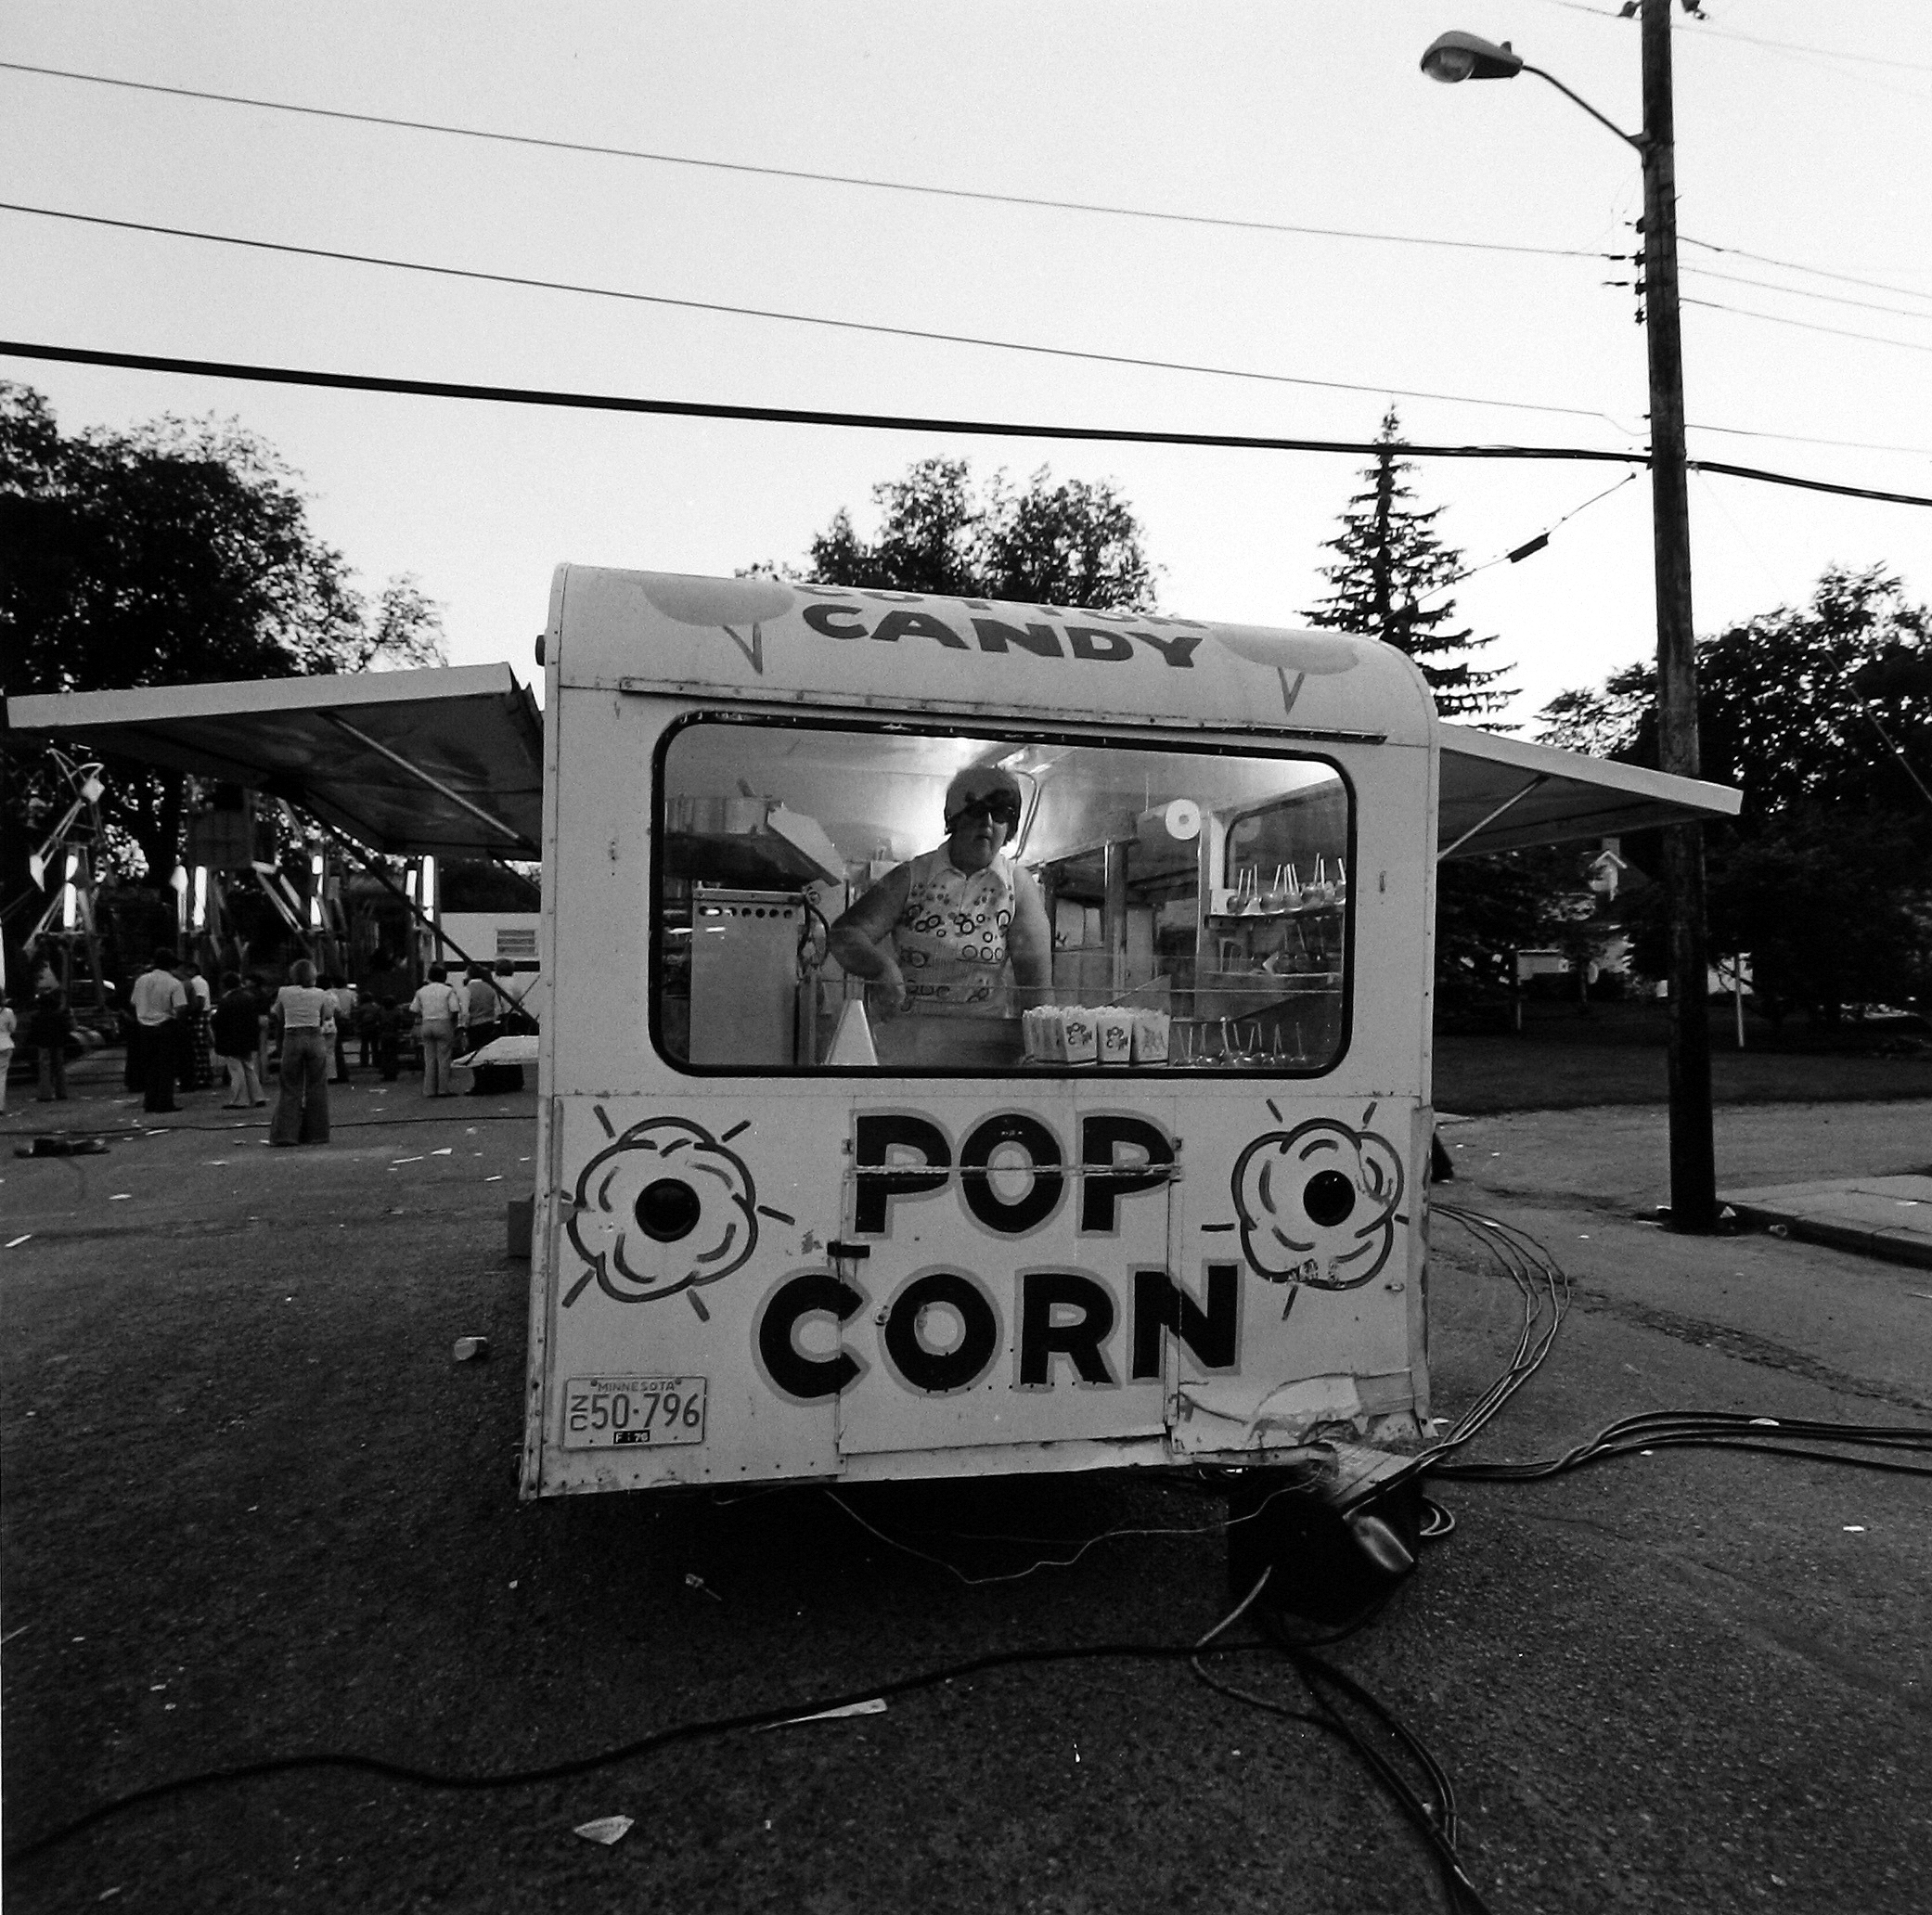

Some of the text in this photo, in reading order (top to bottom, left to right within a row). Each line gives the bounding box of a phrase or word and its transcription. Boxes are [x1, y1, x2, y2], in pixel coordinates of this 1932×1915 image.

[803, 604, 1204, 668] CANDY
[854, 1112, 1176, 1235] POP
[758, 1264, 1240, 1399] CORN
[598, 1381, 675, 1392] MINNESOTA
